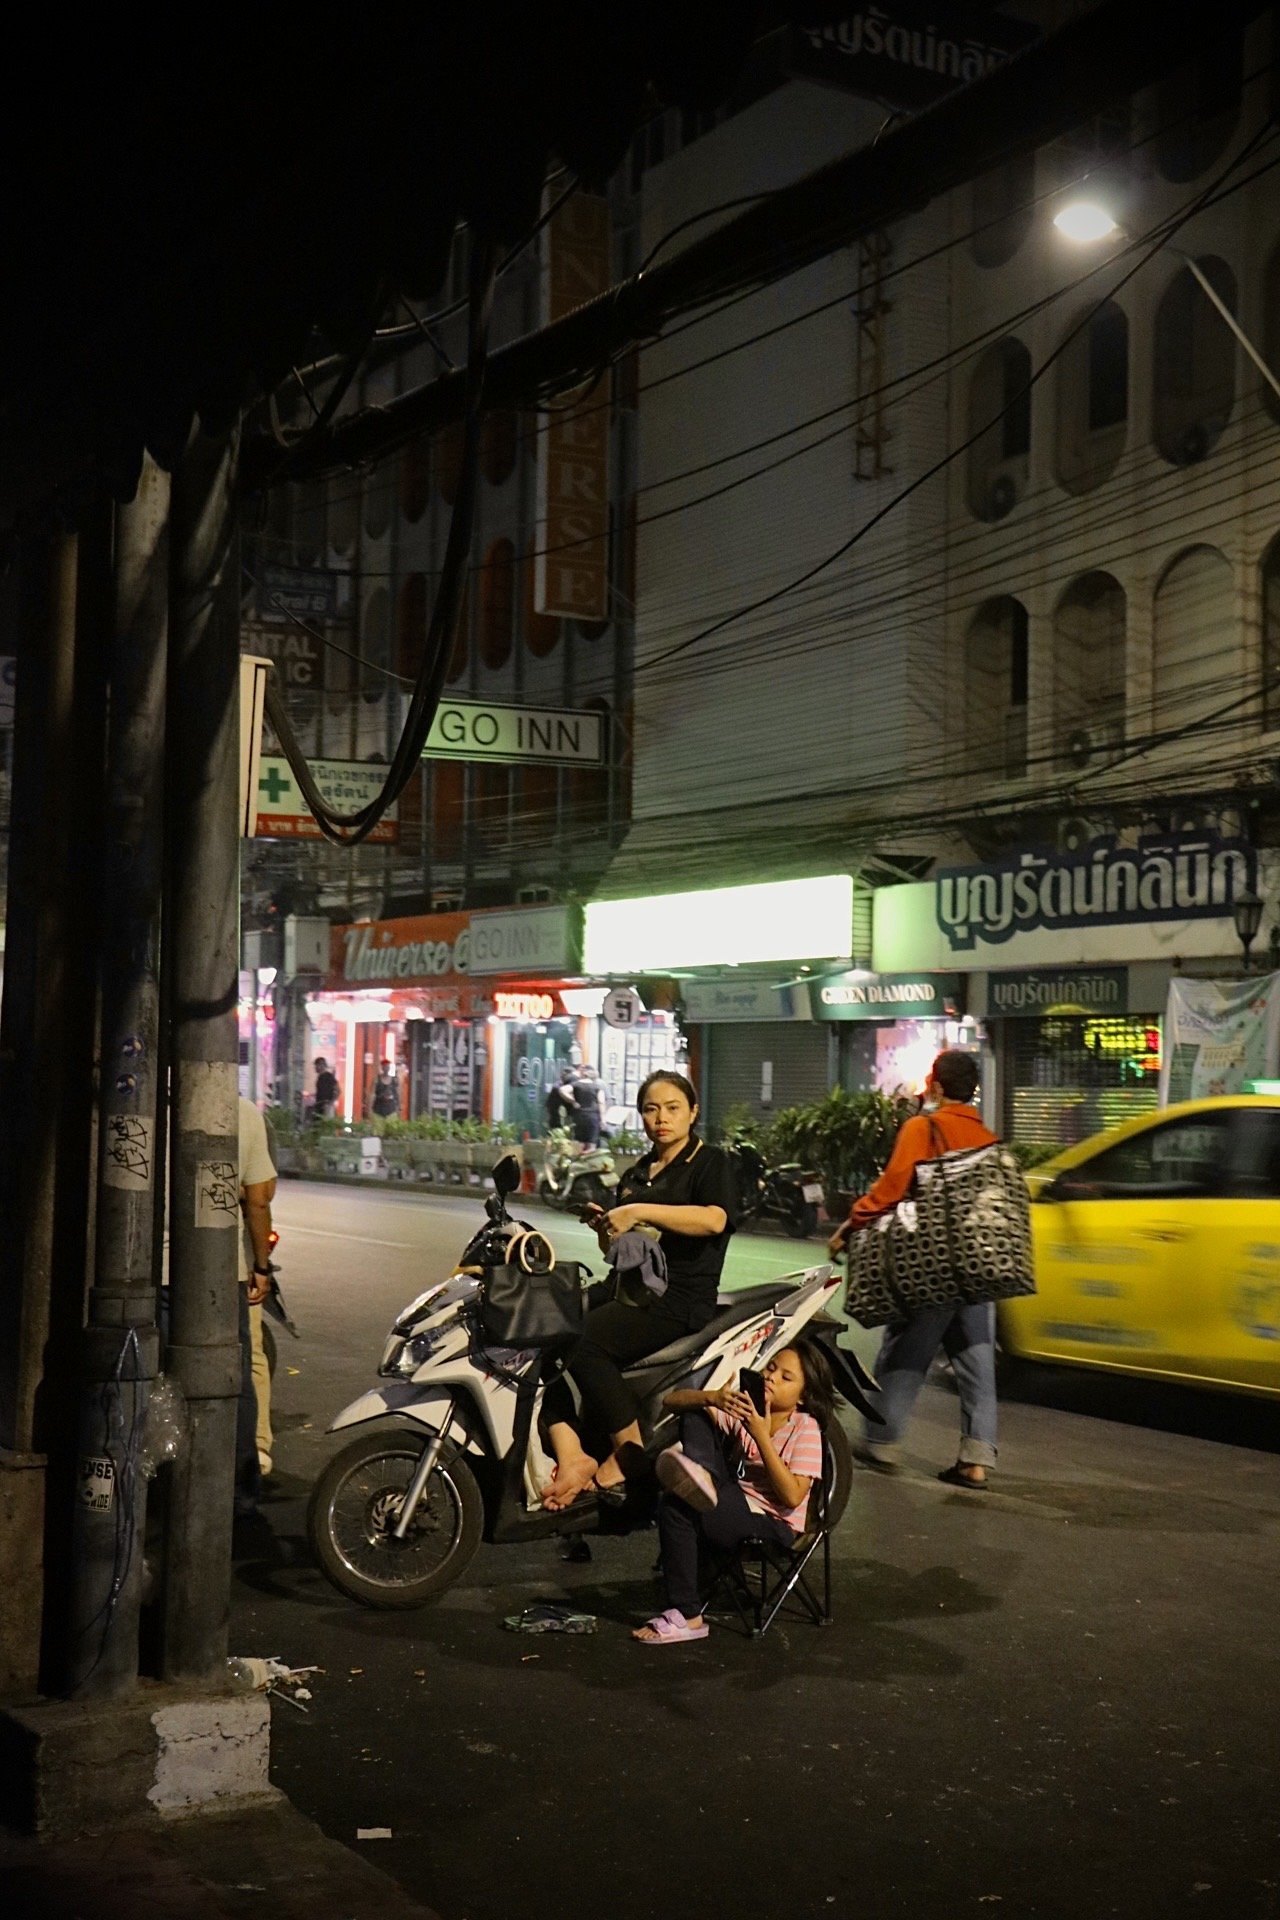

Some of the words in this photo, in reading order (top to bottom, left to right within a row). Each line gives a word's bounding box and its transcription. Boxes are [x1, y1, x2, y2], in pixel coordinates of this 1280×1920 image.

[439, 710, 499, 746] GO
[517, 716, 580, 752] INN
[940, 842, 1248, 938] บุญรัตน์คลินิก
[343, 926, 450, 980] Universe
[473, 930, 501, 959] GO
[504, 924, 541, 957] INN
[868, 983, 936, 1002] DIAMOND
[993, 975, 1119, 1011] บุญรัตน์คลินิก
